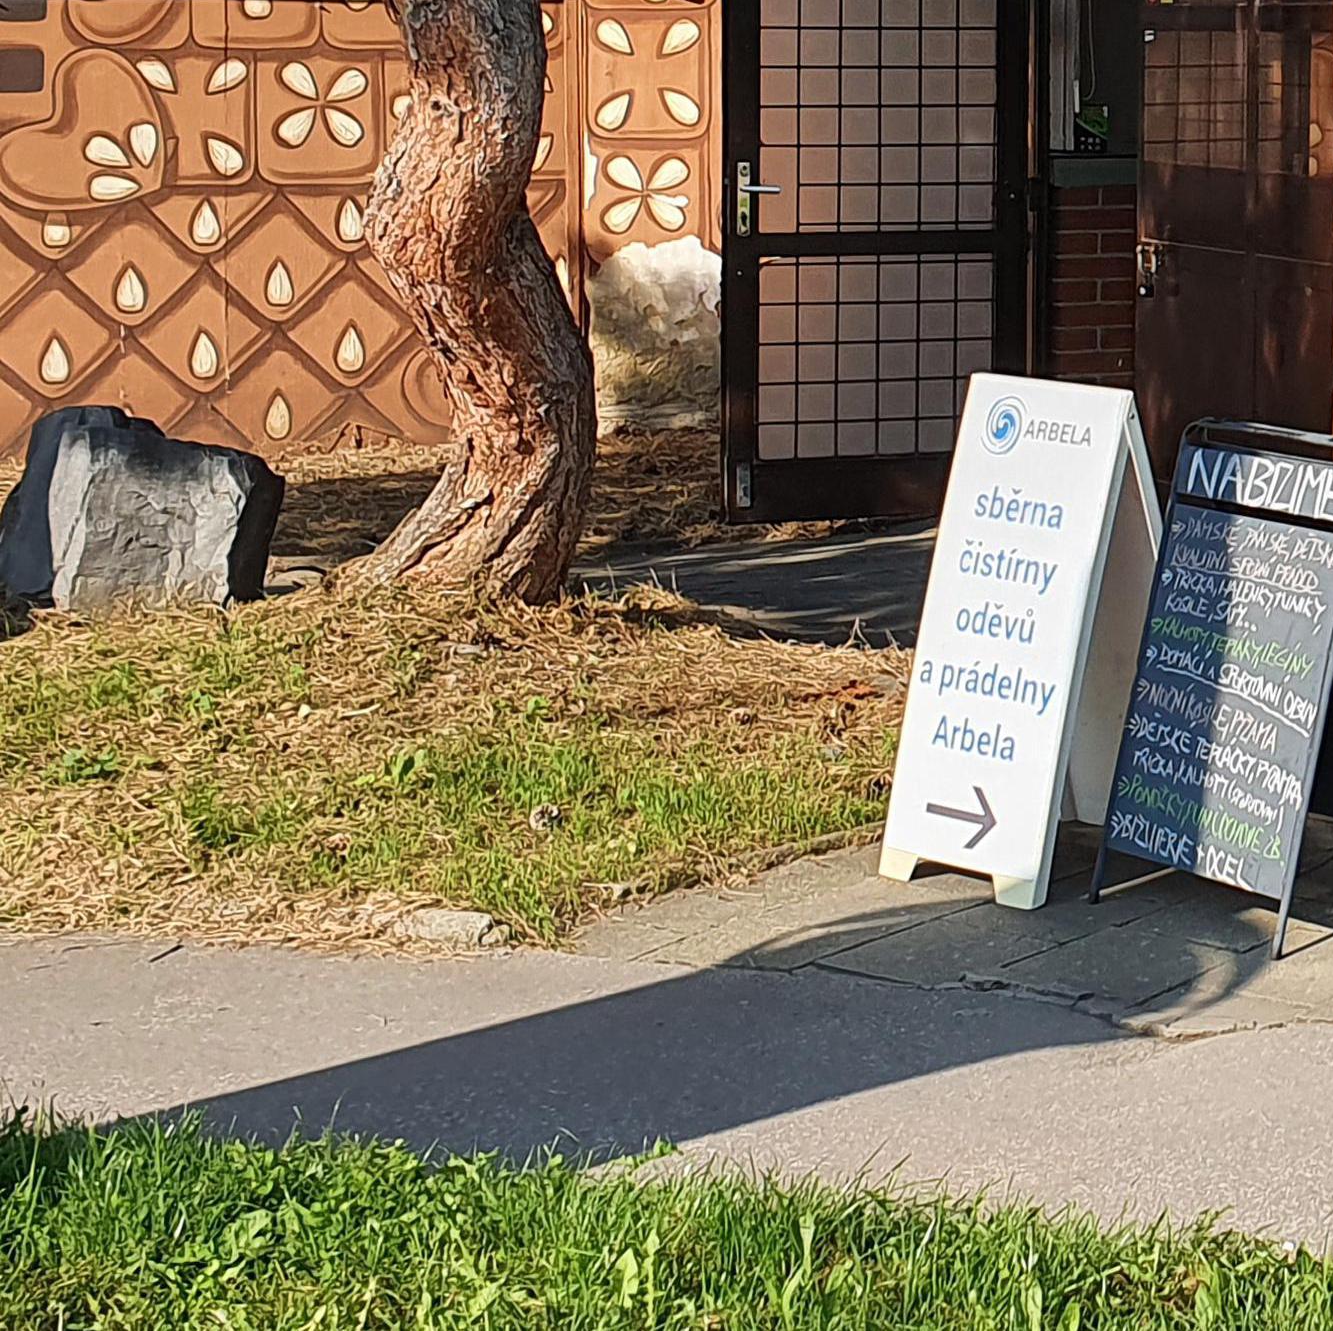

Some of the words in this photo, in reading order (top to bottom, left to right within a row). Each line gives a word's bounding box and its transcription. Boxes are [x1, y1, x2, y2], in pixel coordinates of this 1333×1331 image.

[1023, 420, 1091, 447] ARBELA
[975, 485, 1063, 529] sběrna
[959, 539, 1058, 595] čistírny
[956, 601, 1036, 644] oděvů
[920, 660, 933, 683] a
[938, 660, 1056, 716] prádelny
[932, 715, 1015, 762] Arbela
